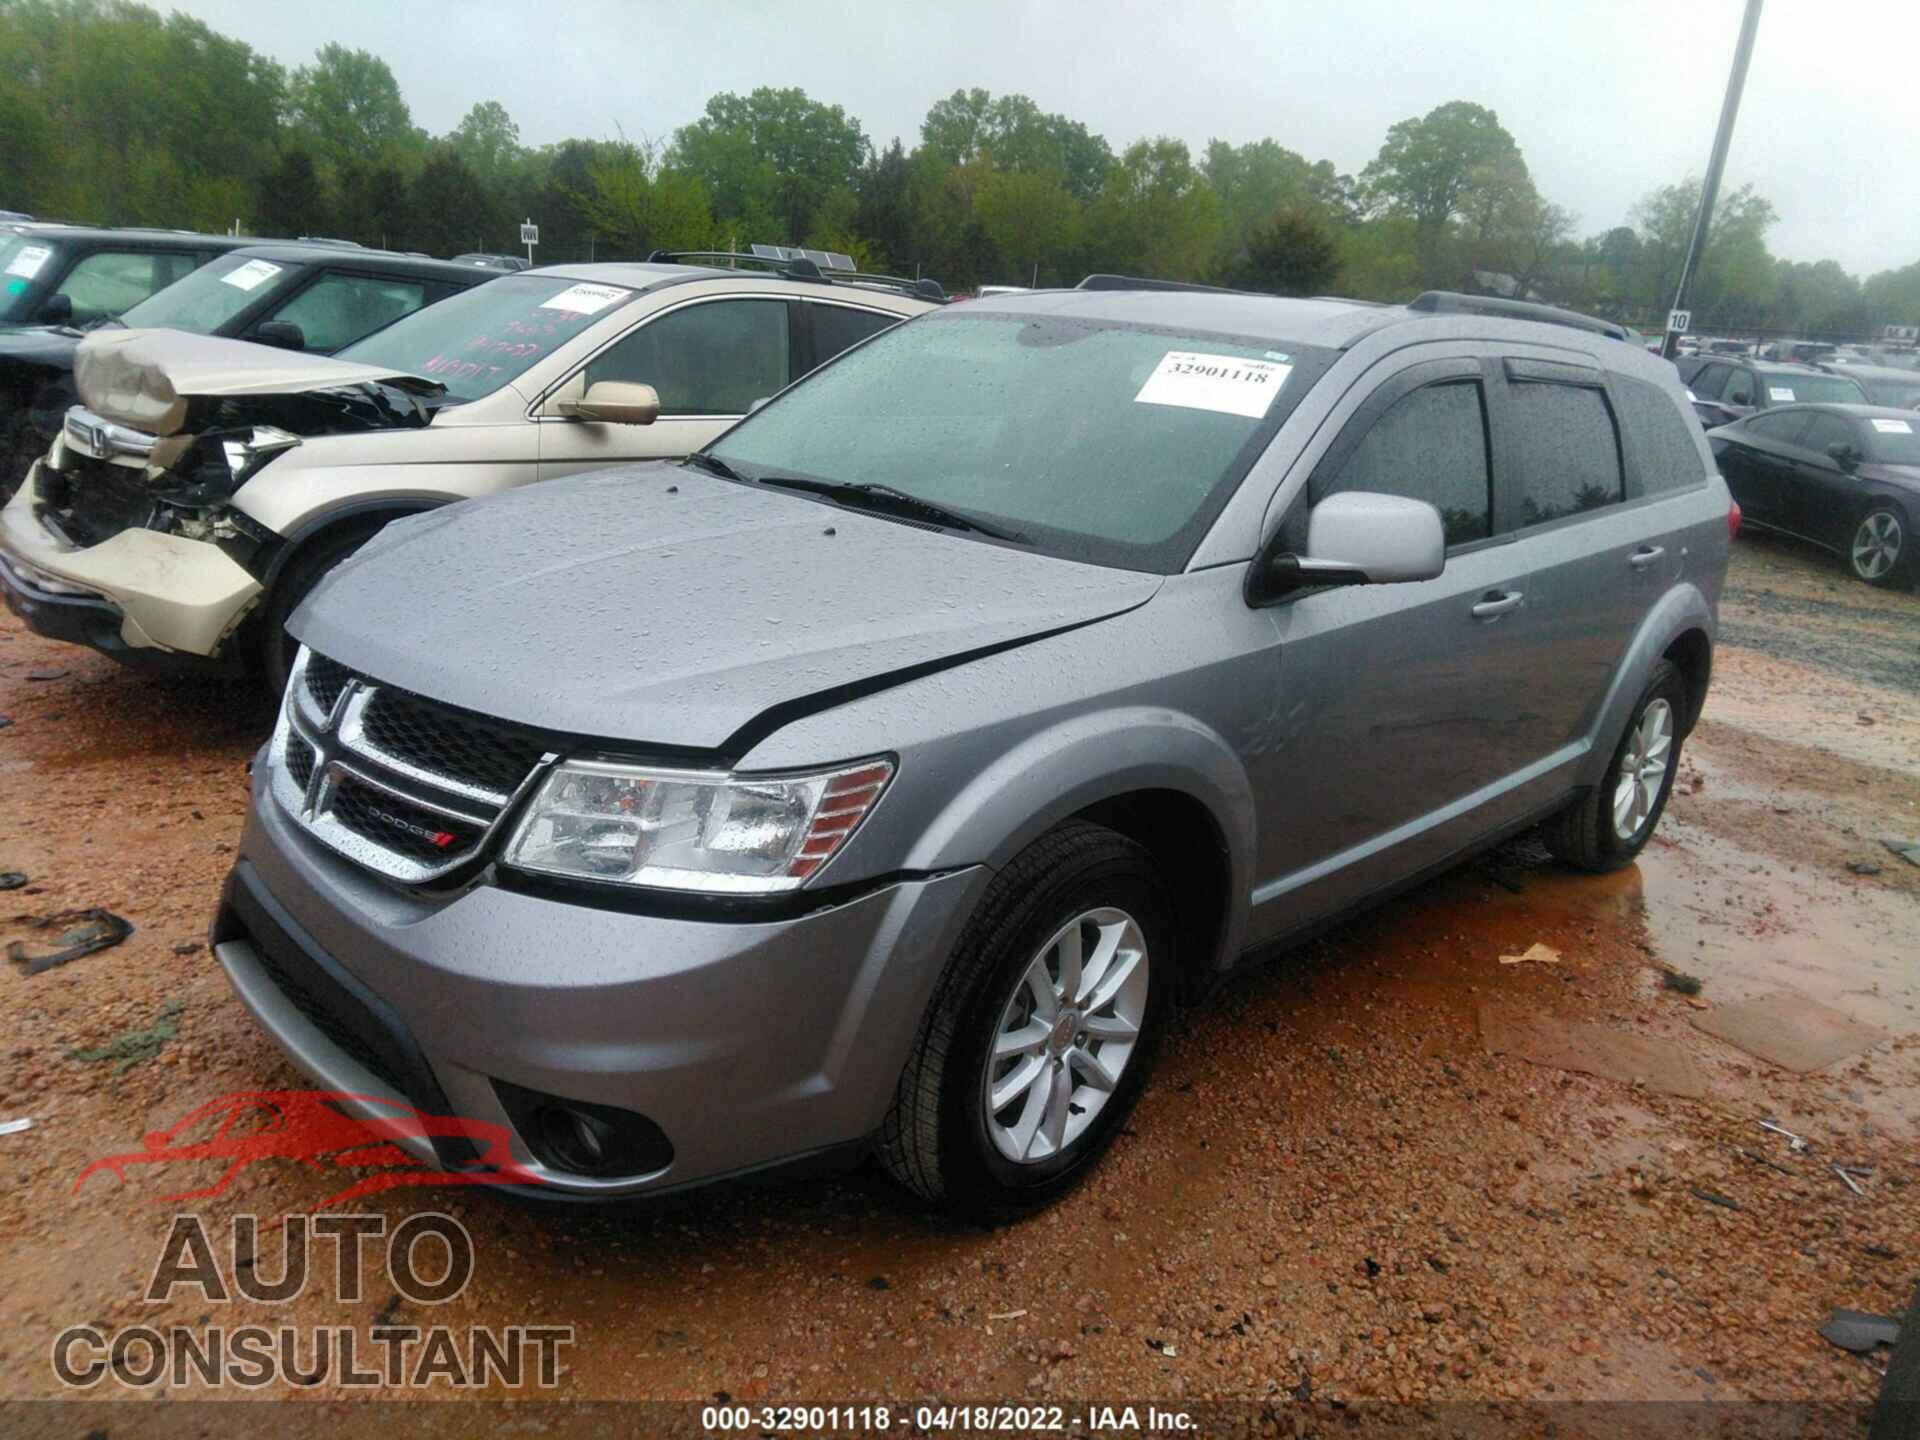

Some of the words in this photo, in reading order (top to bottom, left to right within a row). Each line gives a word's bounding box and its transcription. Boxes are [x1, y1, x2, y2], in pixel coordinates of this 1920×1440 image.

[1671, 313, 1687, 329] 10
[1167, 362, 1269, 384] 32901118
[368, 806, 437, 842] DODGE
